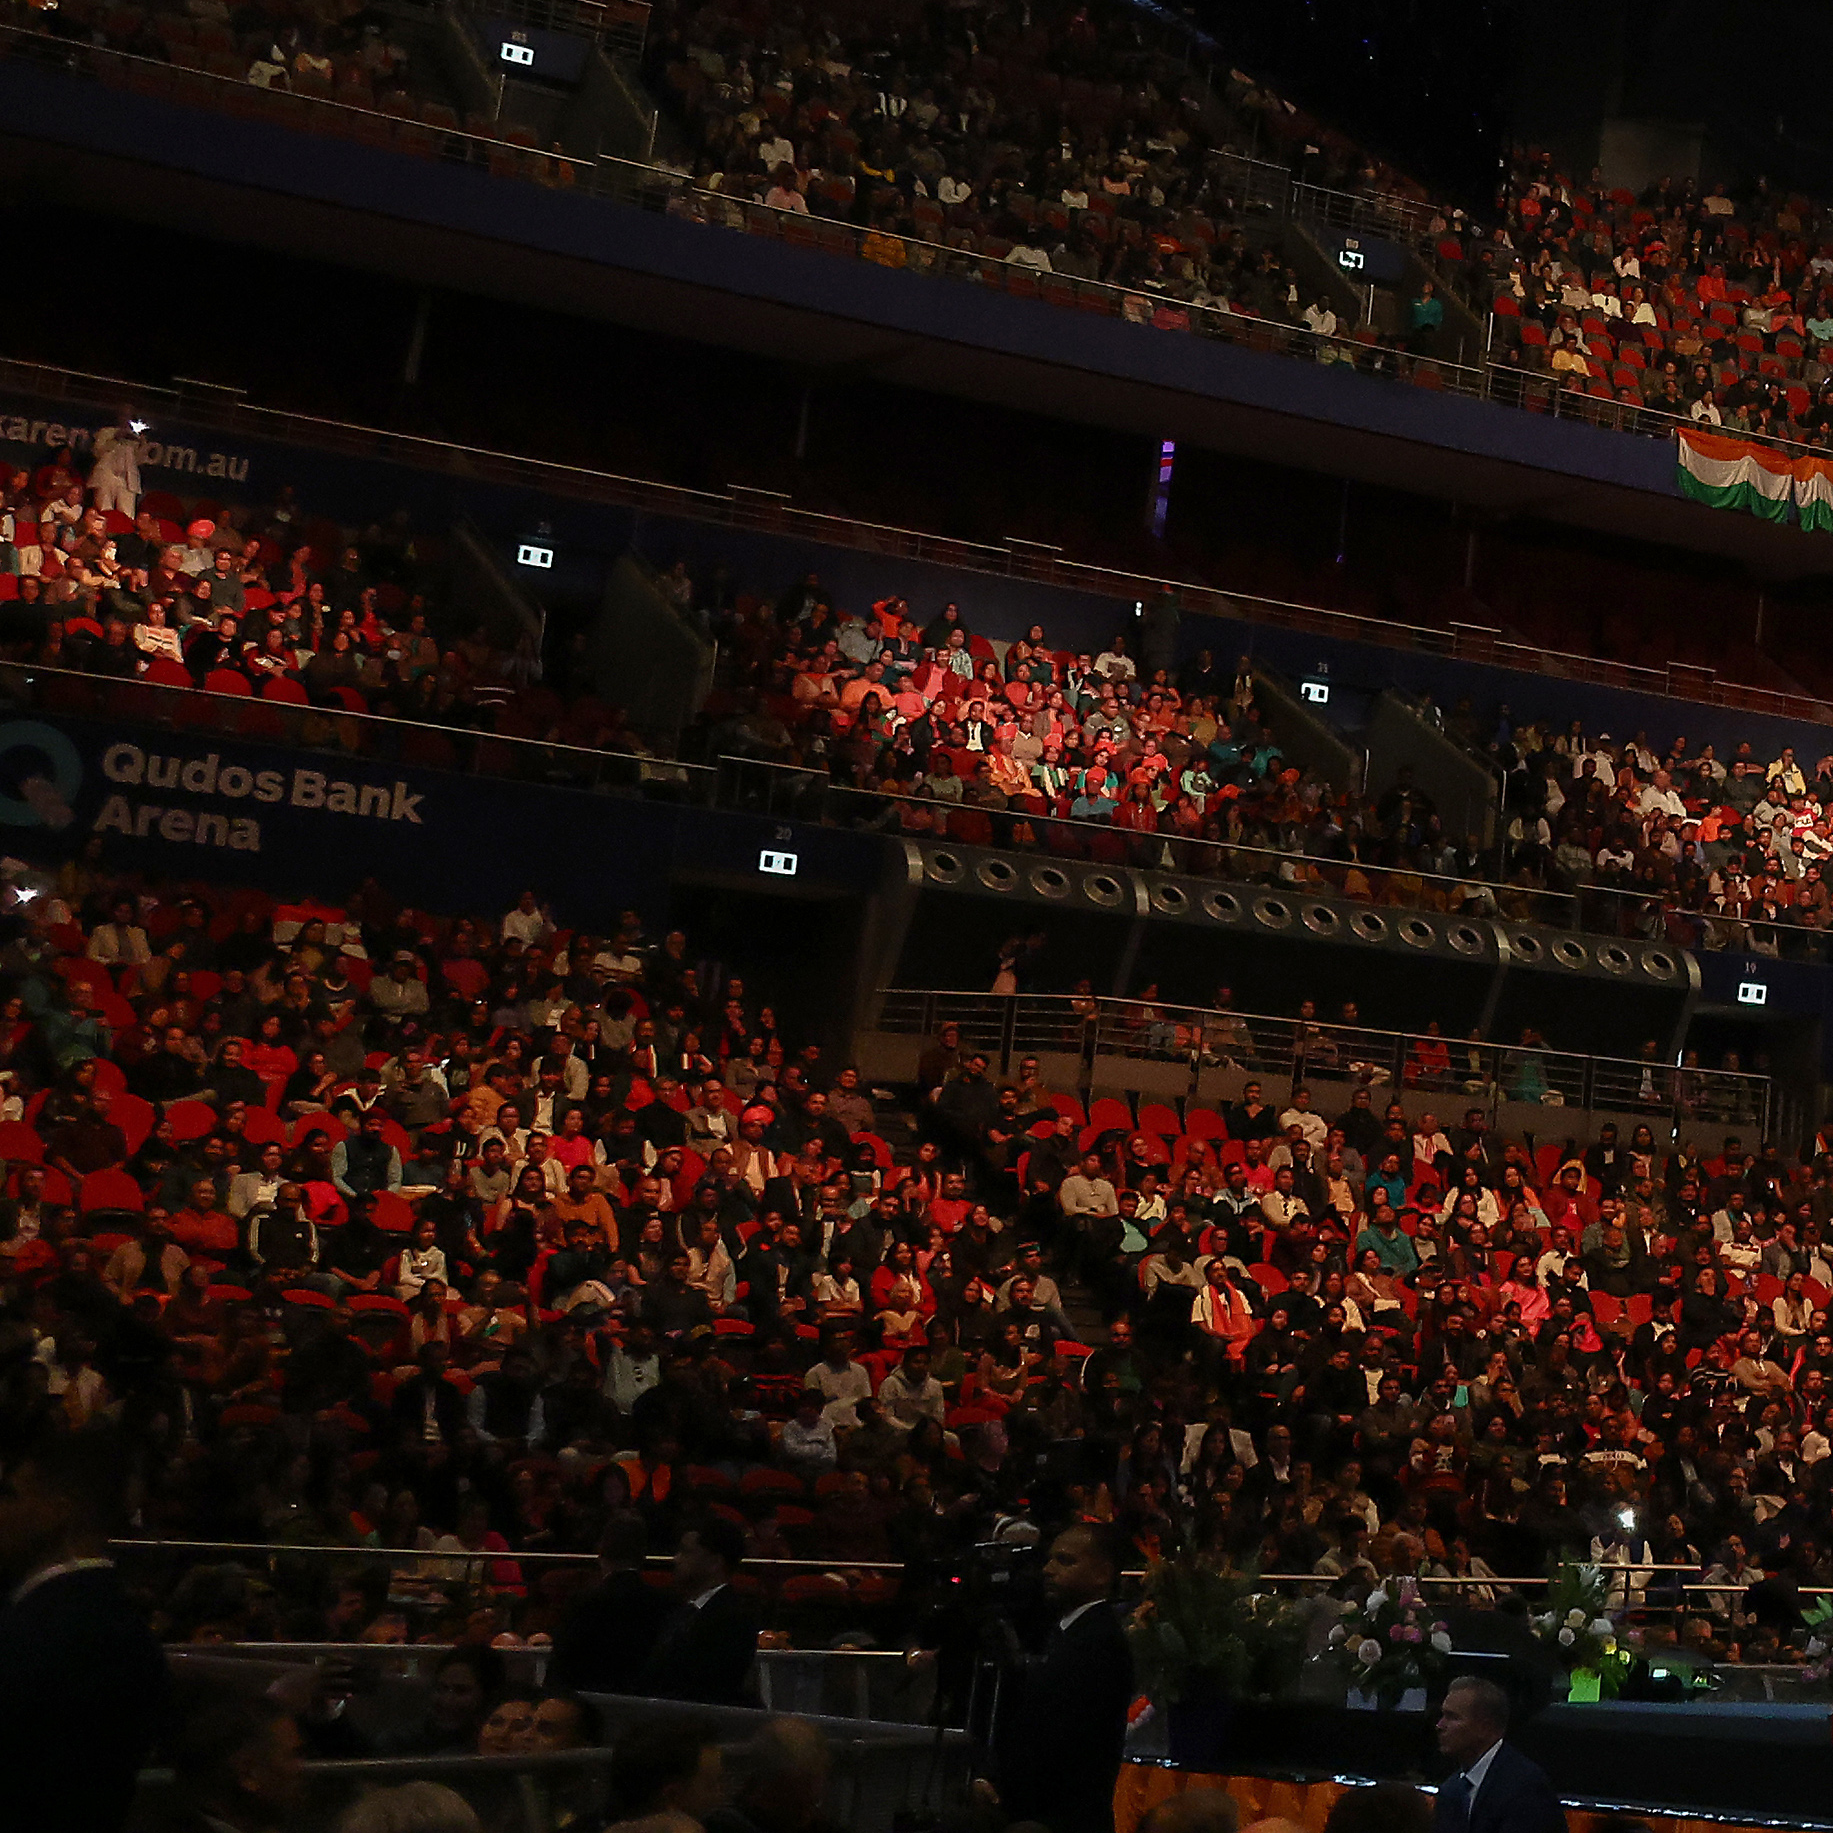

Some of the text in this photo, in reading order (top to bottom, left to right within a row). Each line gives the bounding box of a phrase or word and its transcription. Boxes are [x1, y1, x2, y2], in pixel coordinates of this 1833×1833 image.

[102, 742, 425, 825] Qudos Bank
[93, 793, 261, 852] Arena
